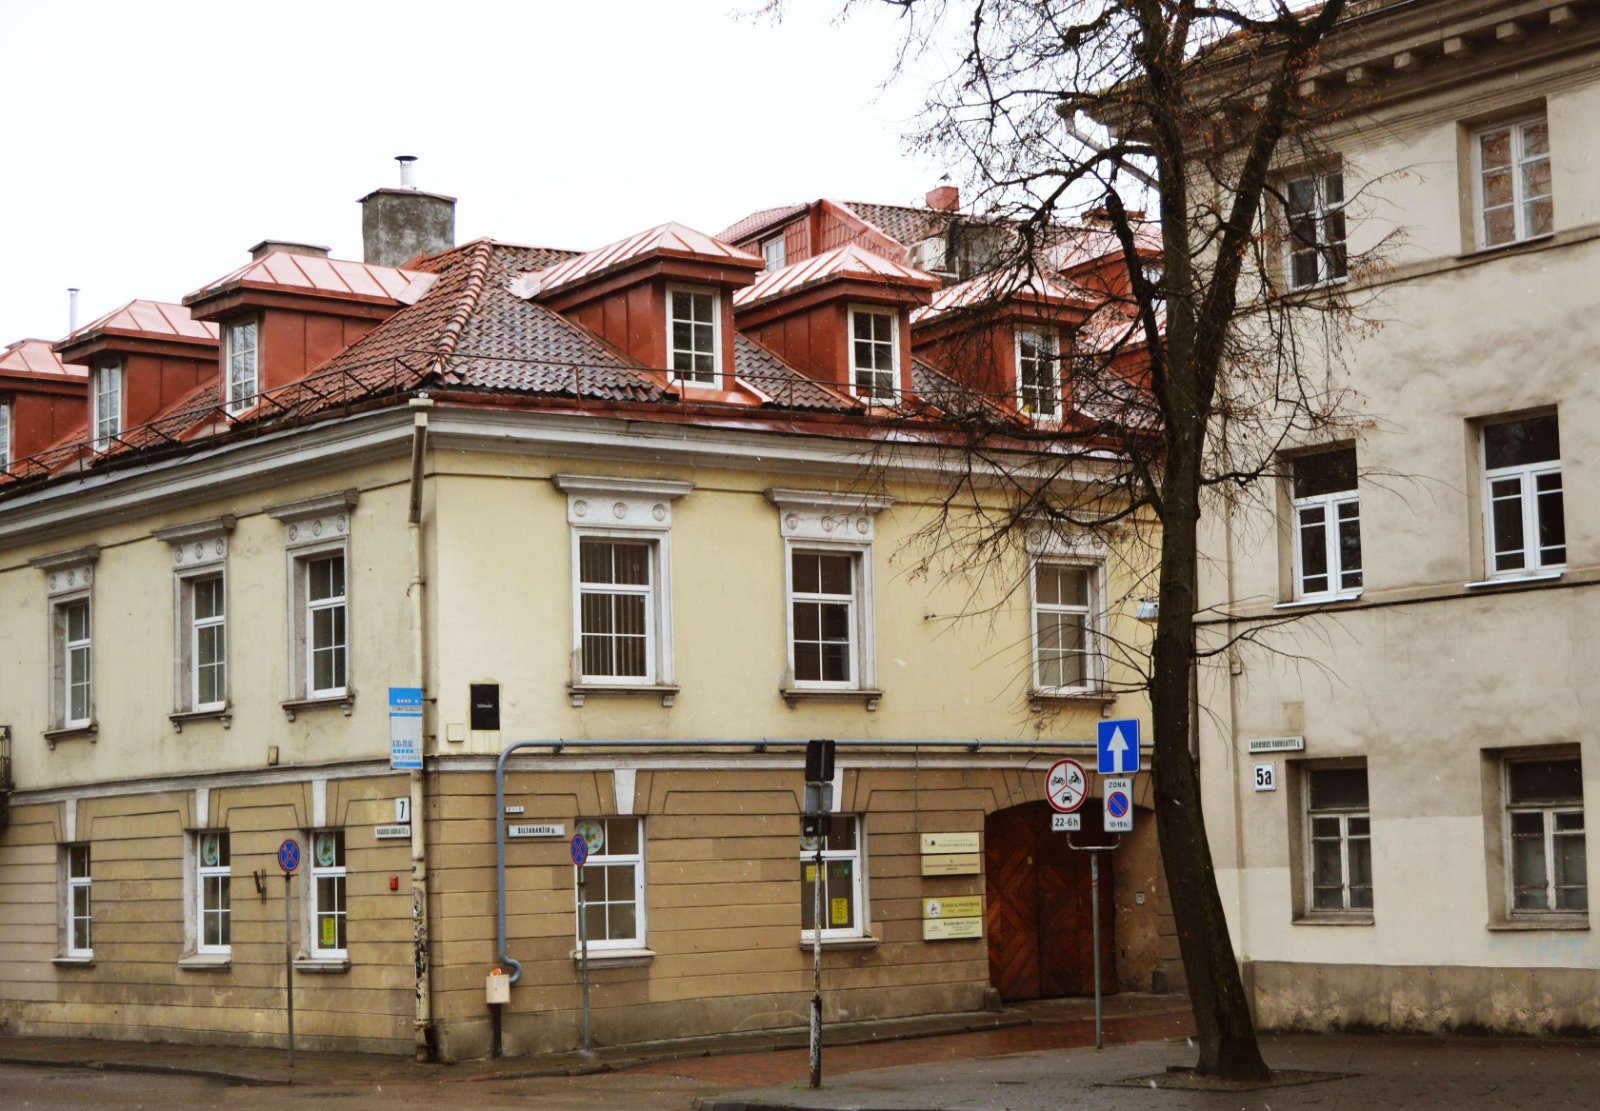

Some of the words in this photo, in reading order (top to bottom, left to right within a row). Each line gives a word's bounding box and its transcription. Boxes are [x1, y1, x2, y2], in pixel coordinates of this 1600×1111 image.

[1108, 781, 1127, 789] ZONA
[1256, 768, 1272, 786] 5a
[400, 801, 405, 819] 7
